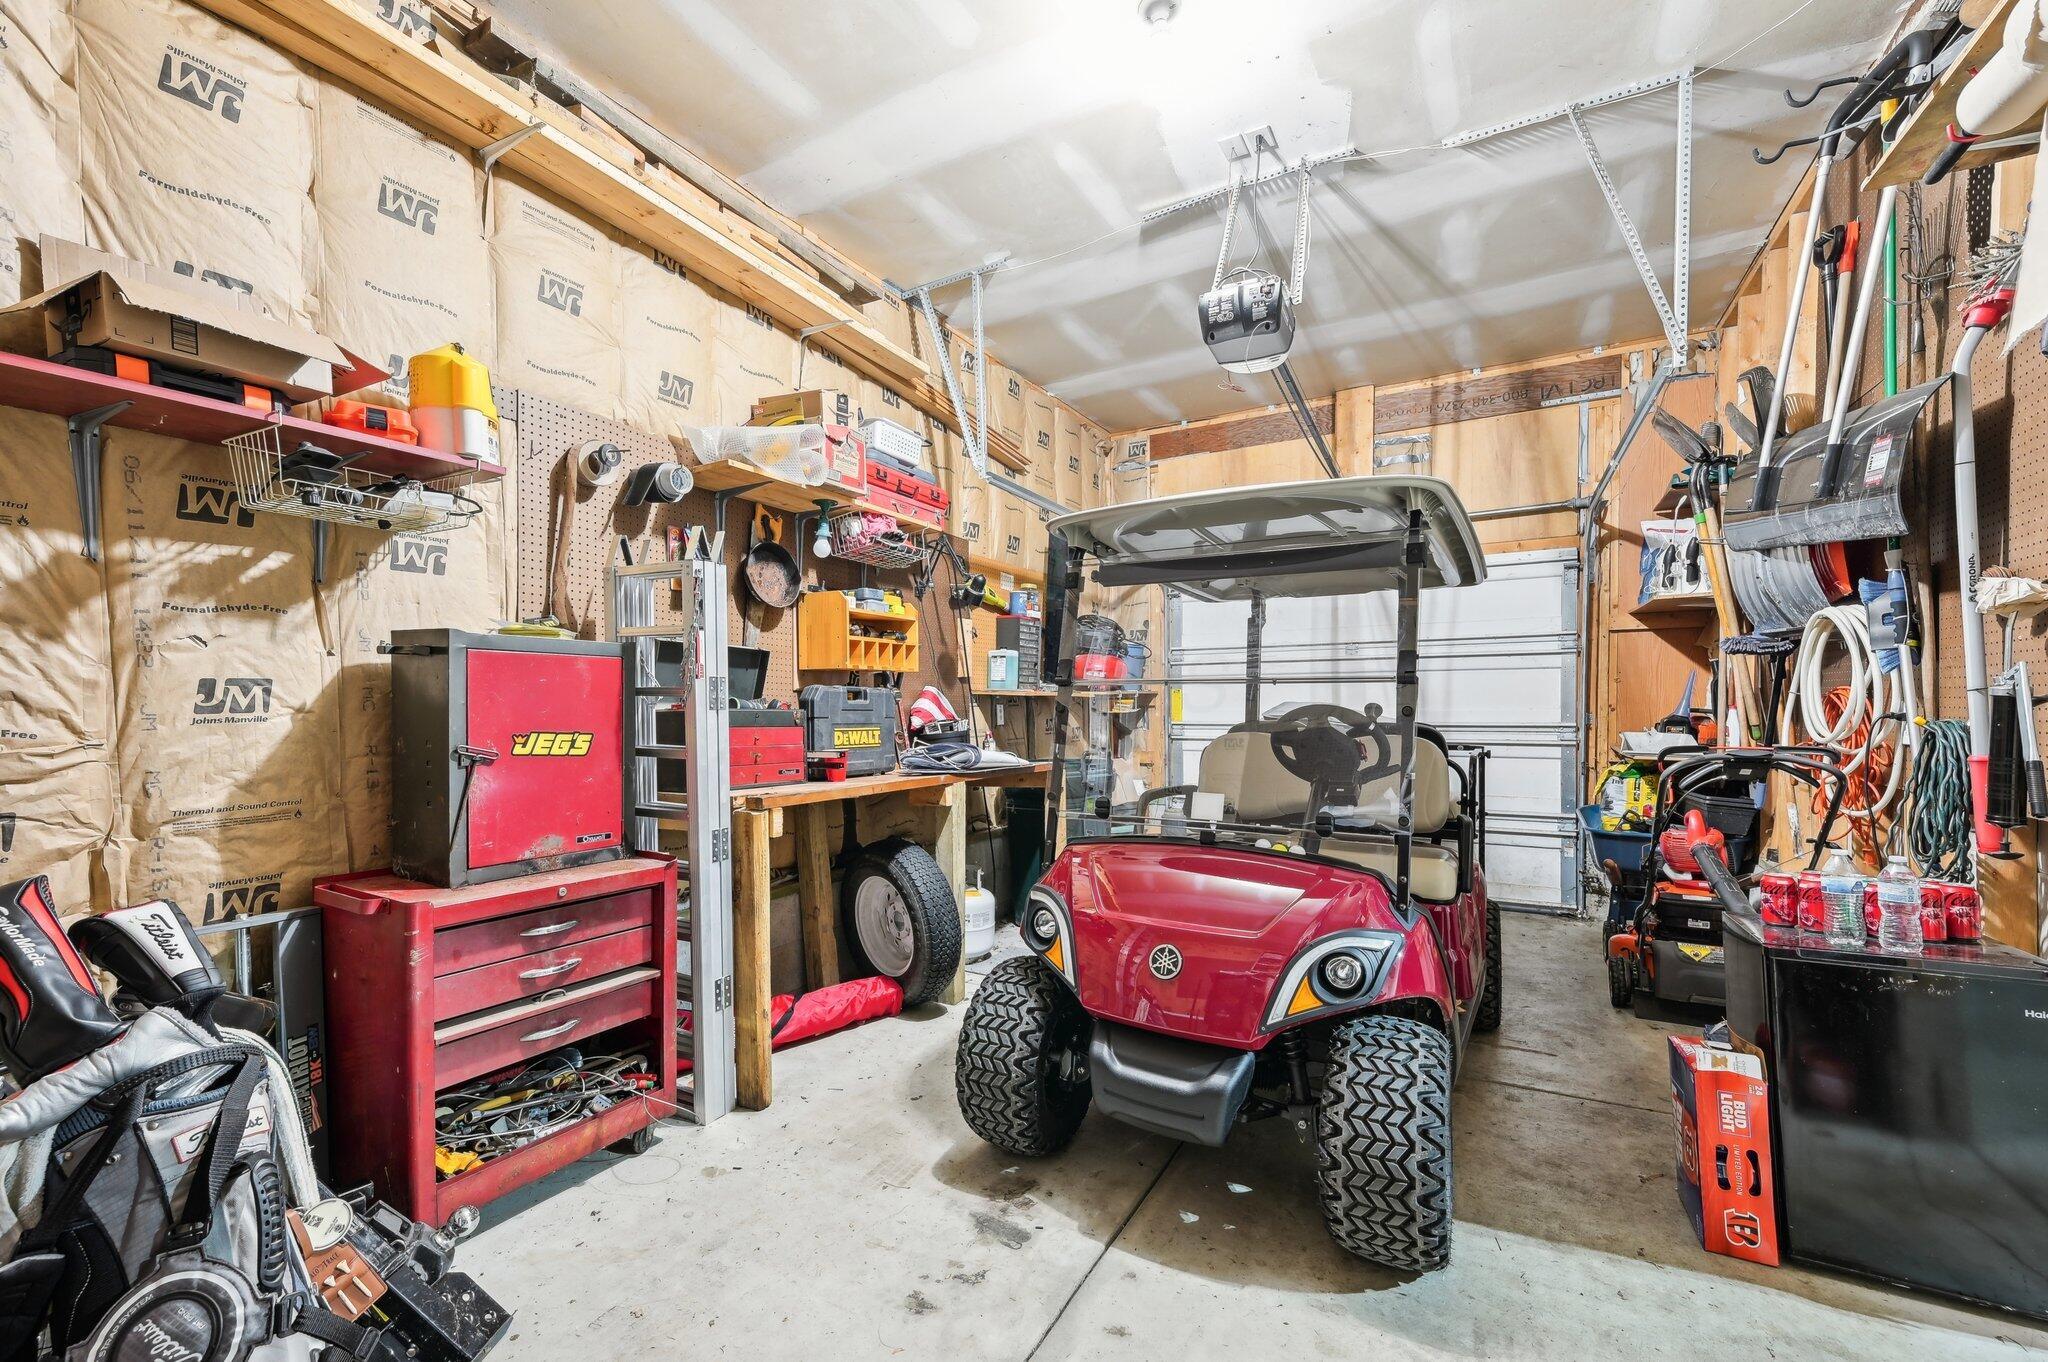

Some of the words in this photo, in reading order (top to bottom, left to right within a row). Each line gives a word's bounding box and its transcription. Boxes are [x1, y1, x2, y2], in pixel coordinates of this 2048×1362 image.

[166, 43, 216, 74] Manville
[158, 53, 245, 124] JM
[217, 67, 248, 89] Johns
[138, 169, 272, 225] Formaldehyde-Free
[382, 174, 418, 195] Manville
[377, 182, 438, 235] JM
[521, 200, 546, 217] Thermal
[546, 212, 558, 222] and
[558, 217, 576, 232] Sound
[576, 225, 595, 242] Control
[364, 279, 458, 319] Formaldehyde-Free
[537, 274, 583, 317] JM
[658, 370, 694, 405] JM
[181, 472, 228, 488] Manville
[0, 500, 29, 510] ntrol
[390, 540, 448, 576] JM
[161, 601, 288, 615] Formaldehyde-Free
[193, 677, 273, 715] JM
[190, 716, 223, 726] Johns
[224, 715, 269, 725] Manville
[172, 806, 215, 818] Thermal
[216, 804, 235, 813] and
[237, 801, 268, 811] Sound
[270, 798, 303, 807] Control
[208, 877, 254, 890] Manville
[253, 871, 285, 882] Johns
[203, 881, 282, 927] JM
[1720, 1092, 1735, 1133] LIGHT
[1734, 1099, 1747, 1130] BUD
[1733, 1144, 1742, 1169] LIMITED
[1735, 1170, 1743, 1197] EDITION
